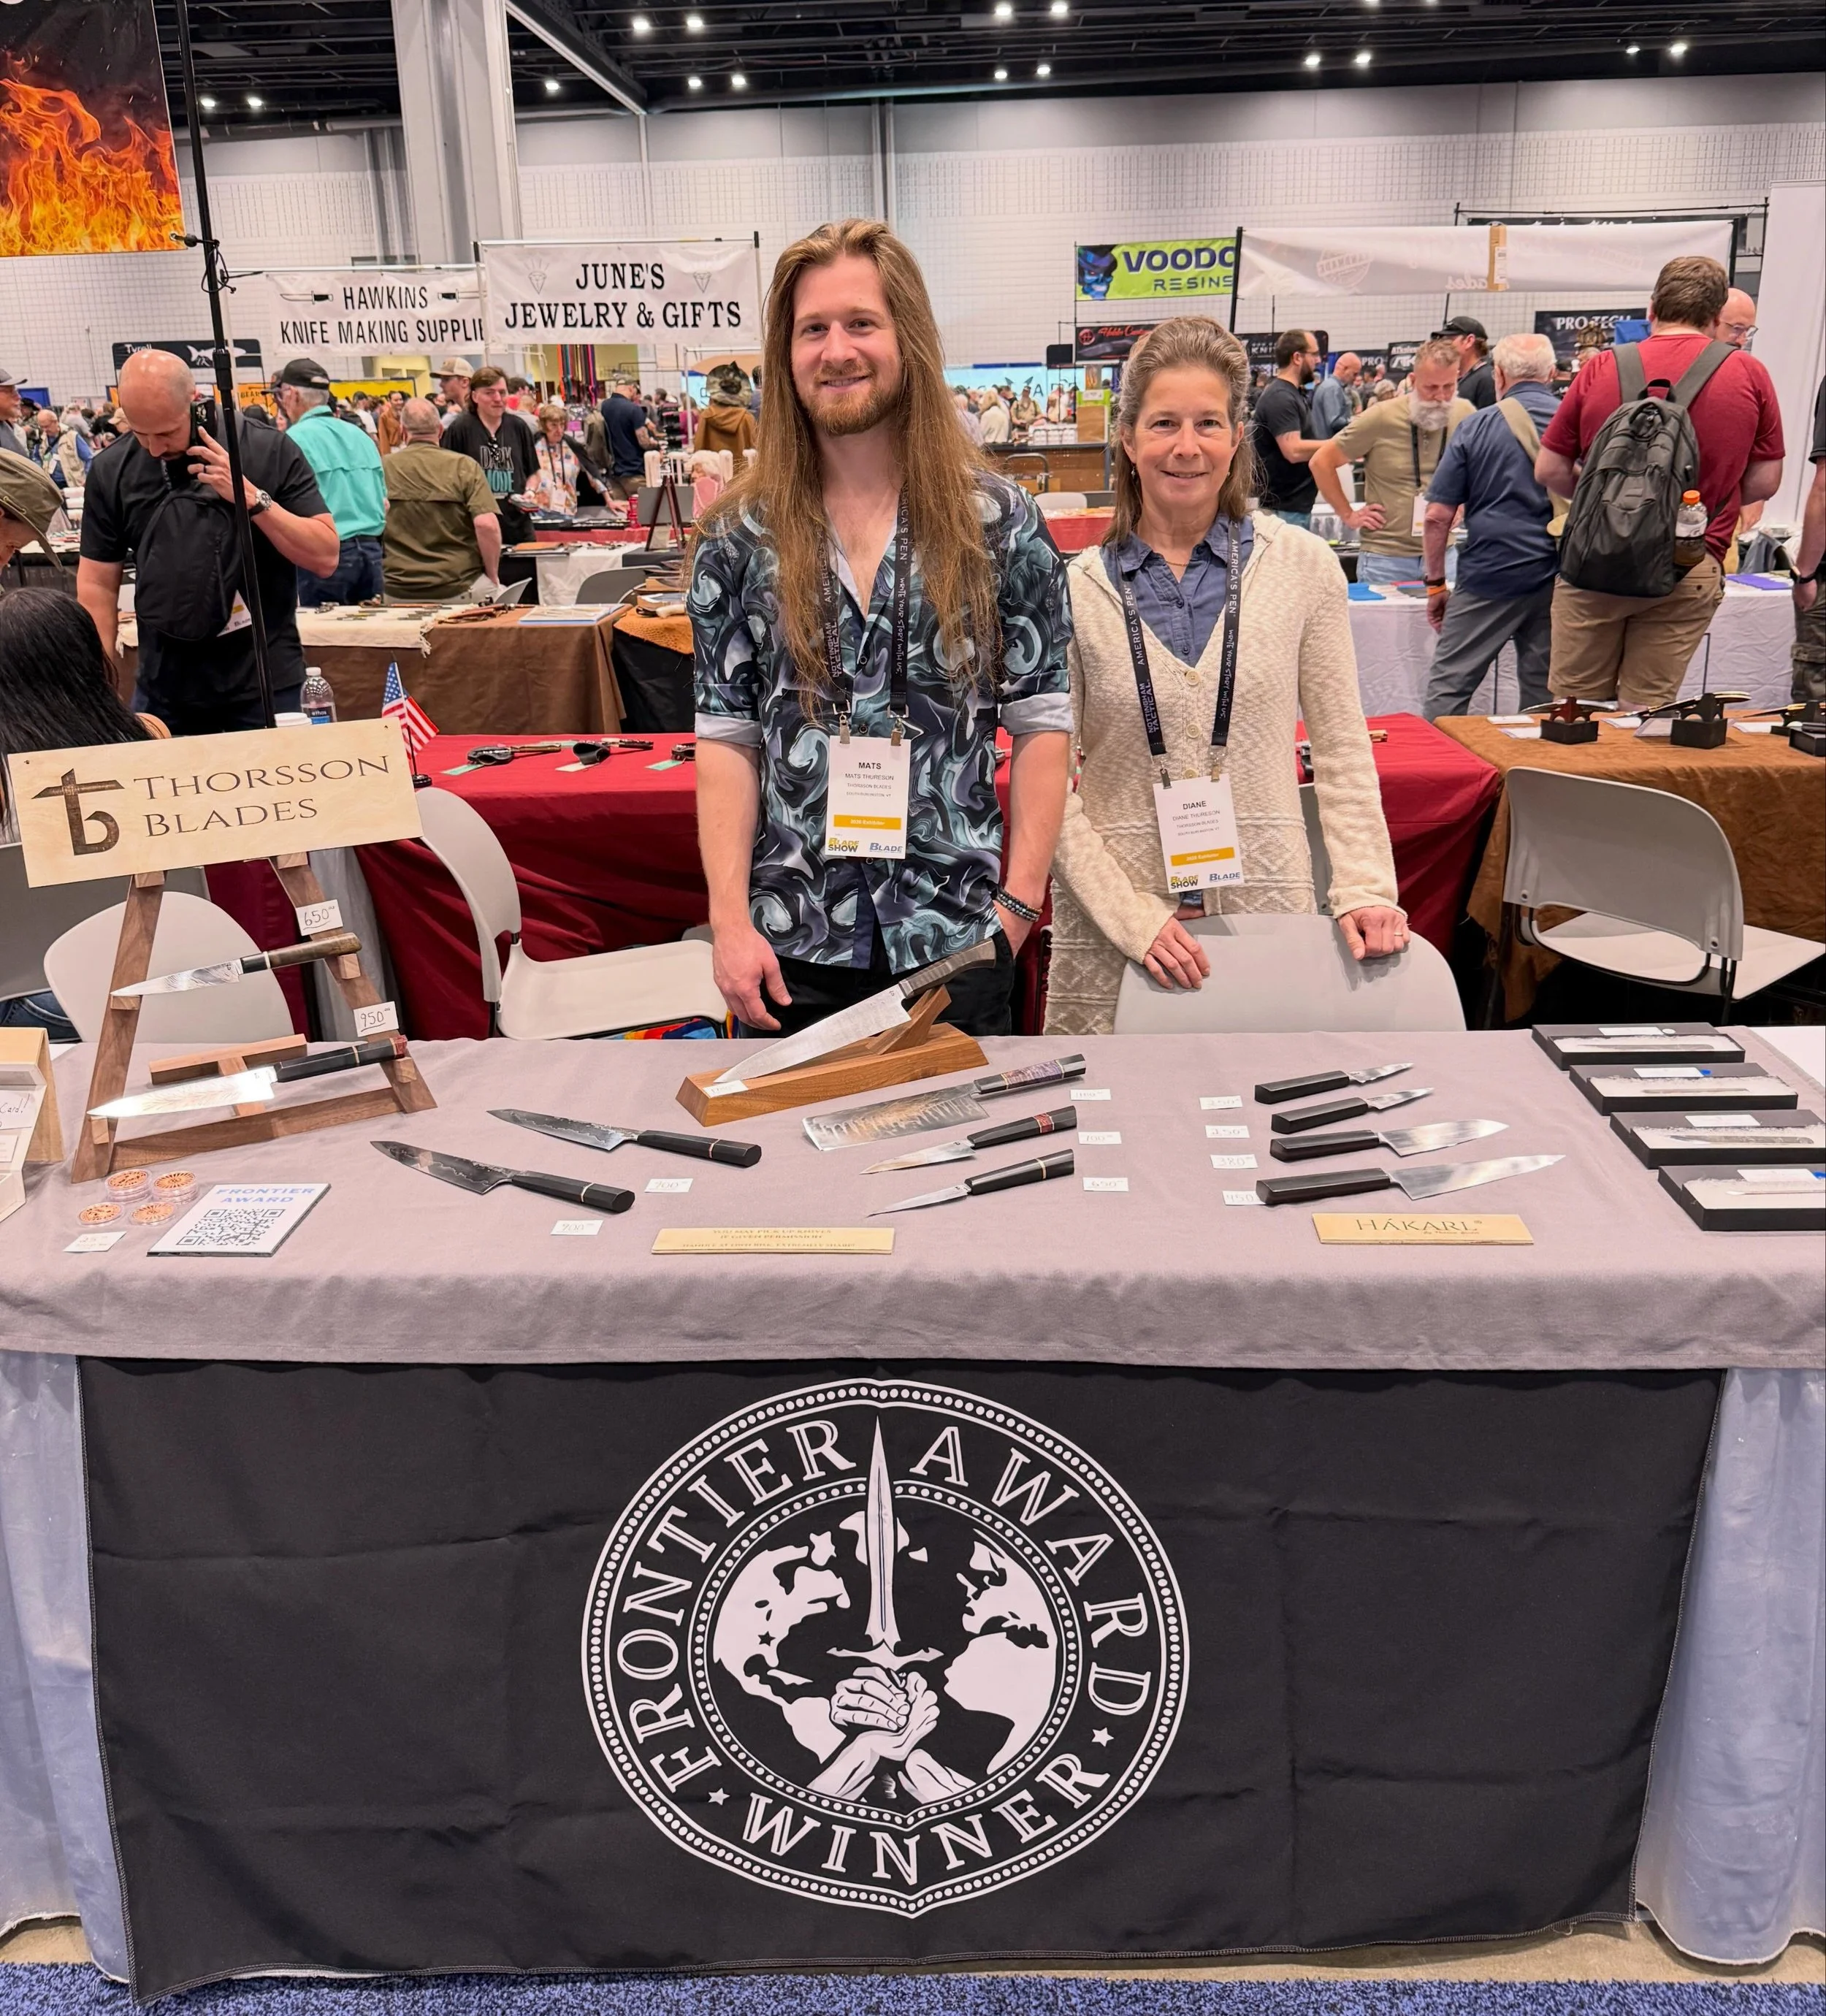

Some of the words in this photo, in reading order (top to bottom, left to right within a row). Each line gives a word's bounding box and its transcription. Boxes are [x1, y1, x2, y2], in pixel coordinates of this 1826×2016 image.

[576, 262, 665, 290] JUNE'S
[343, 286, 428, 310] HAWKINS
[505, 302, 627, 328] JEWELRY
[636, 302, 654, 327] &
[662, 301, 741, 328] GIFTS
[280, 321, 330, 344] KNIFE
[338, 320, 408, 343] MAKING
[1230, 539, 1239, 590] AMERICA'S
[825, 622, 838, 678] NOTTINGHAM
[831, 622, 843, 676] TACTICAL
[1128, 609, 1145, 665] AMERICA'S
[1139, 683, 1155, 733] NOTTINGHAM
[1145, 681, 1159, 733] TACTICAL
[134, 755, 390, 801] THORSSON
[858, 762, 882, 770] MATS
[142, 798, 318, 838] BLADES
[1183, 801, 1207, 810] DIANE
[828, 844, 858, 853] SHOW
[869, 842, 904, 852] BLADE
[1171, 879, 1198, 889] SHOW
[1209, 872, 1240, 882] BLADE
[617, 1419, 857, 1794] FRONTIER
[910, 1425, 1153, 1717] AWARD
[742, 1753, 1110, 1886] WINNER
